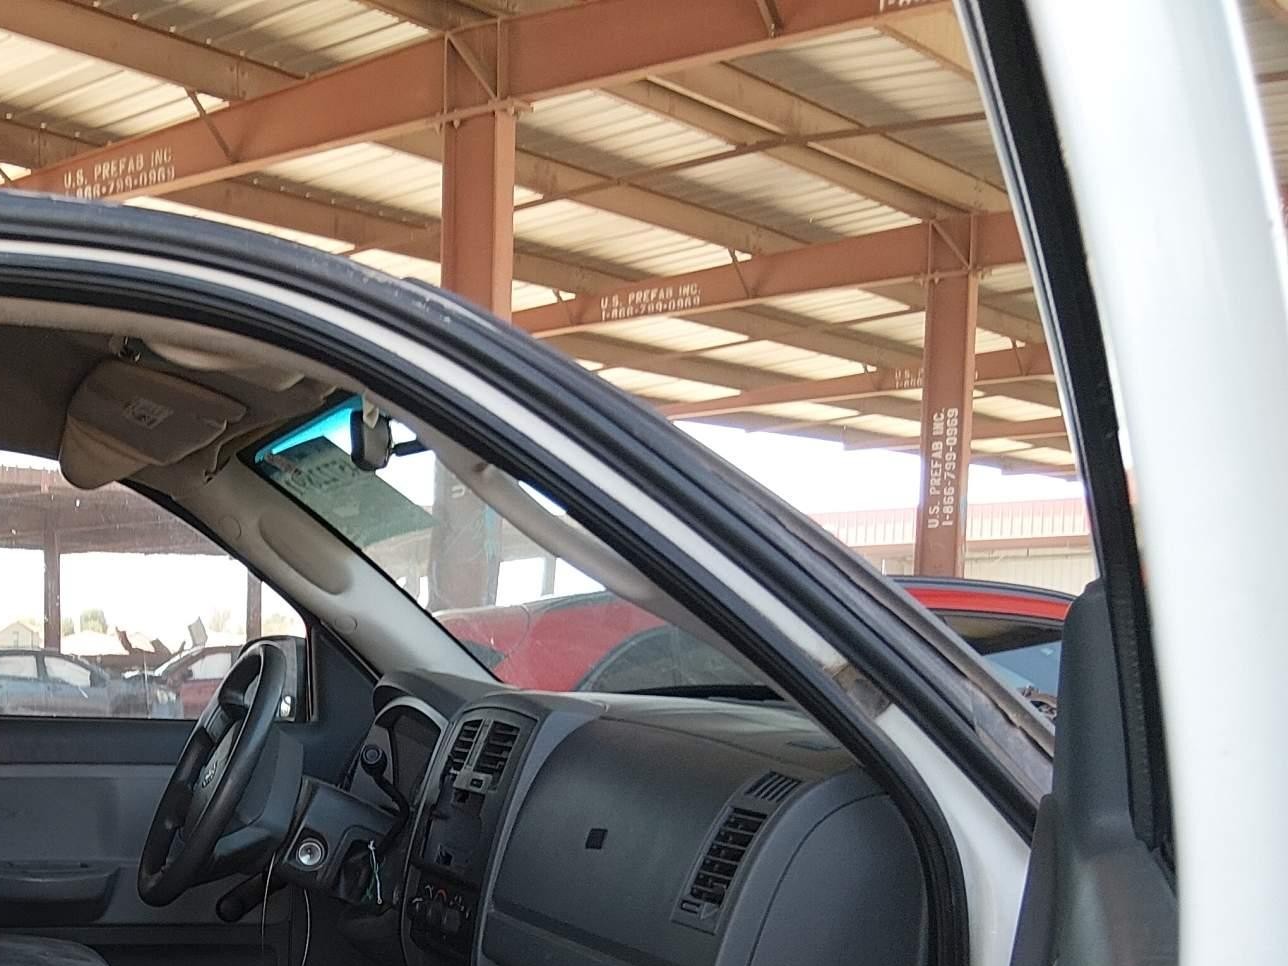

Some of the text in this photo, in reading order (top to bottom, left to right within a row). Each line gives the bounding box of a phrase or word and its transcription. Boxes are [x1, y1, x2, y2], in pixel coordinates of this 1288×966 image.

[63, 167, 88, 189] U.S.
[94, 152, 144, 181] PREFAB
[628, 287, 673, 305] PREFAB
[927, 407, 946, 529] U.S. PREFAB INC.
[941, 407, 959, 526] 1-866-799-0969
